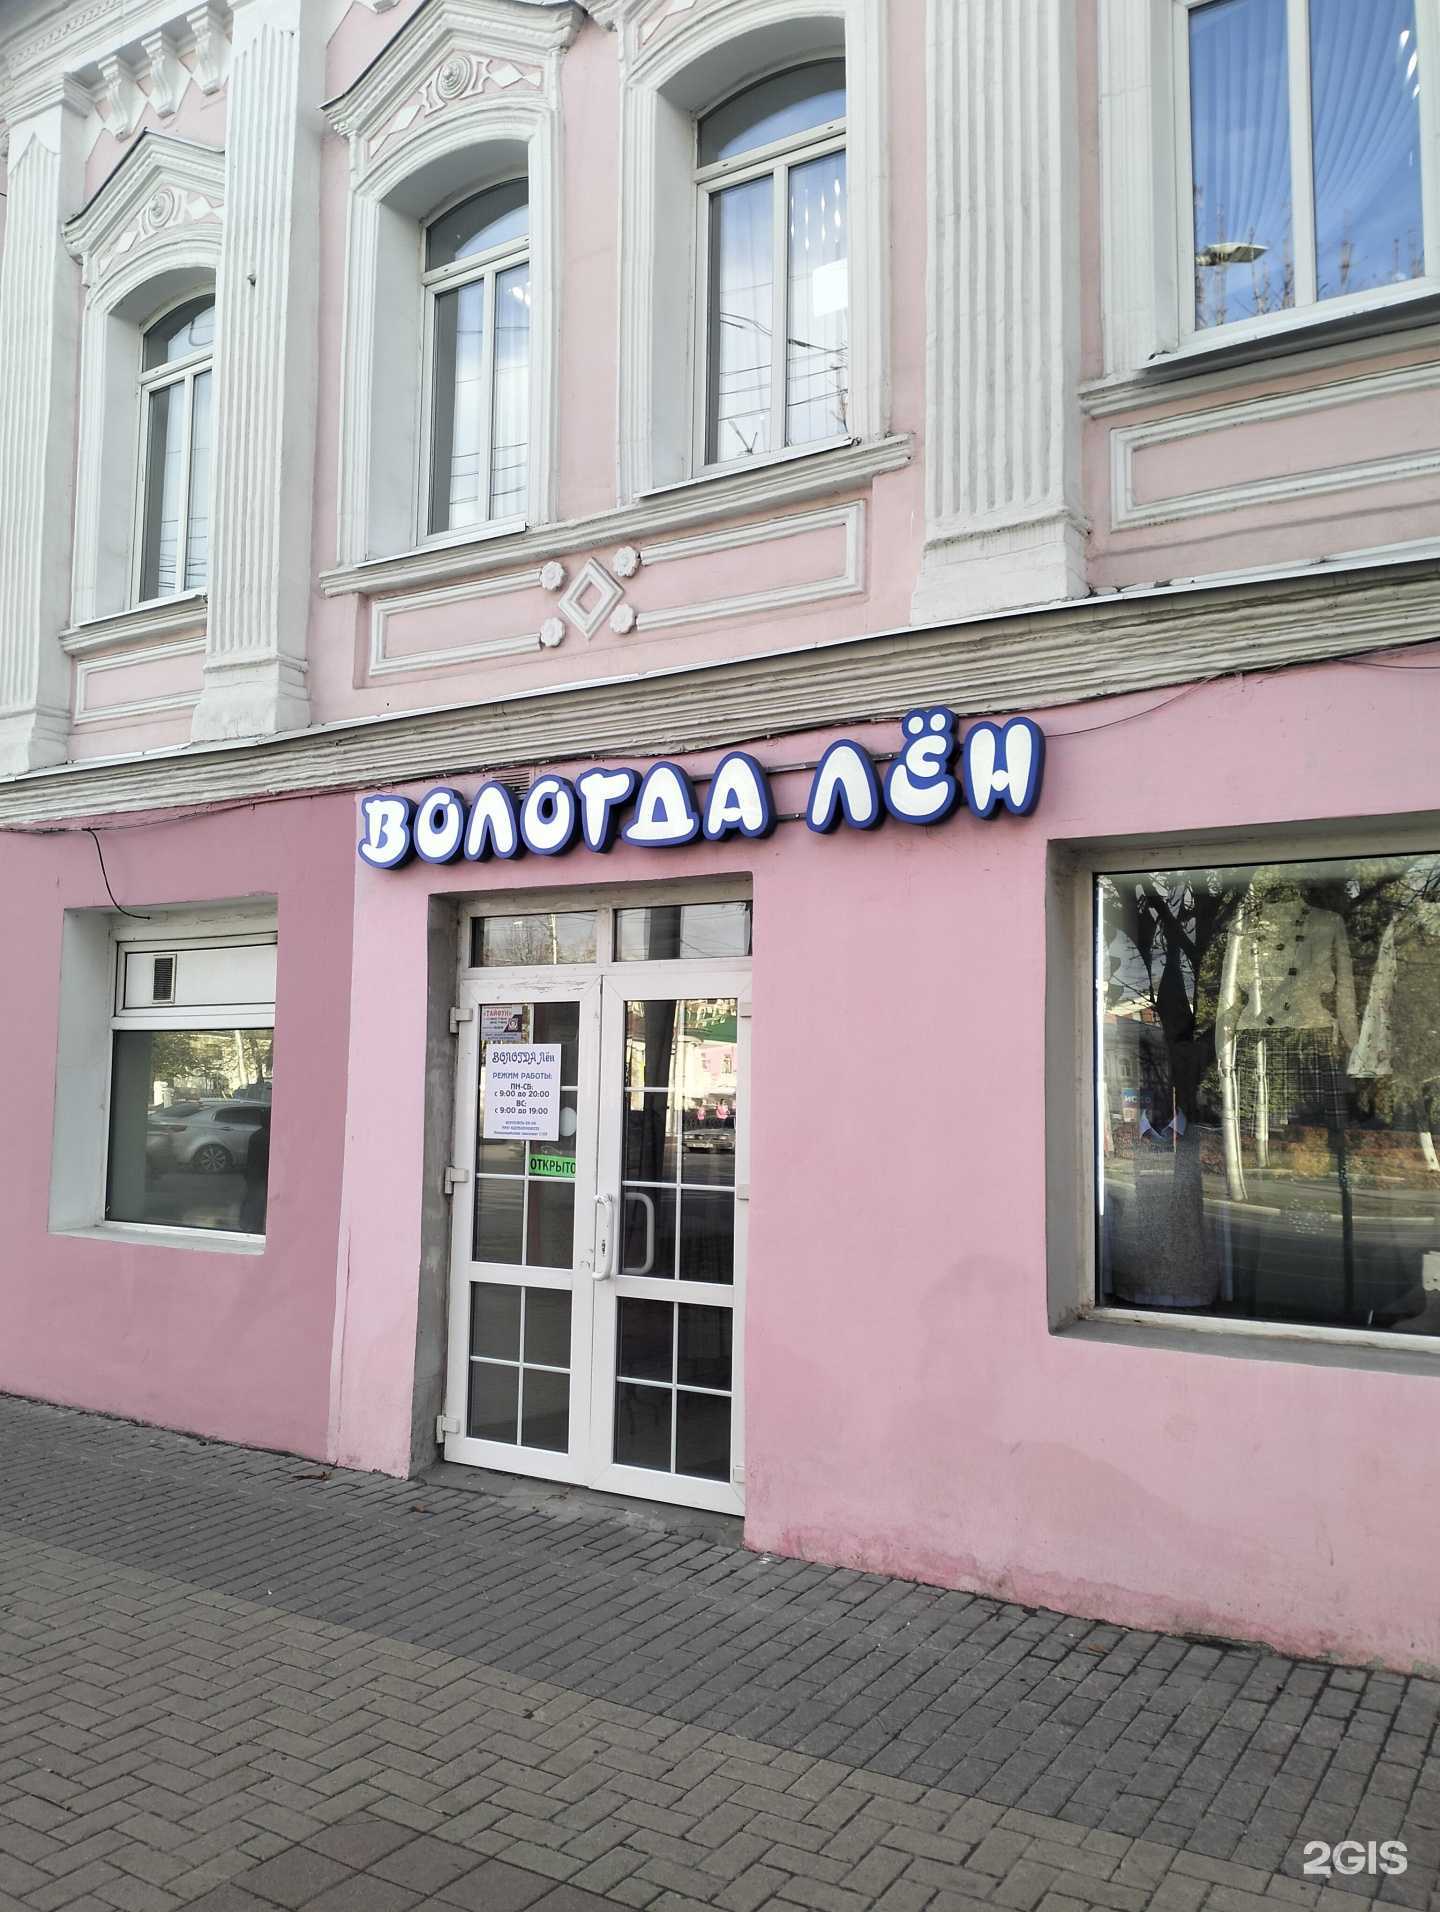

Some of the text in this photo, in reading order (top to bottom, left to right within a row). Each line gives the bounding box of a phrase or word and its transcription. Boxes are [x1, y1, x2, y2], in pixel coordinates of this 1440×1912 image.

[358, 707, 1044, 869] ВОЛОГДА ЛЁН
[499, 1106, 516, 1114] 9:00
[528, 1107, 549, 1115] 19:00
[530, 1158, 577, 1174] ОТКРЫТО
